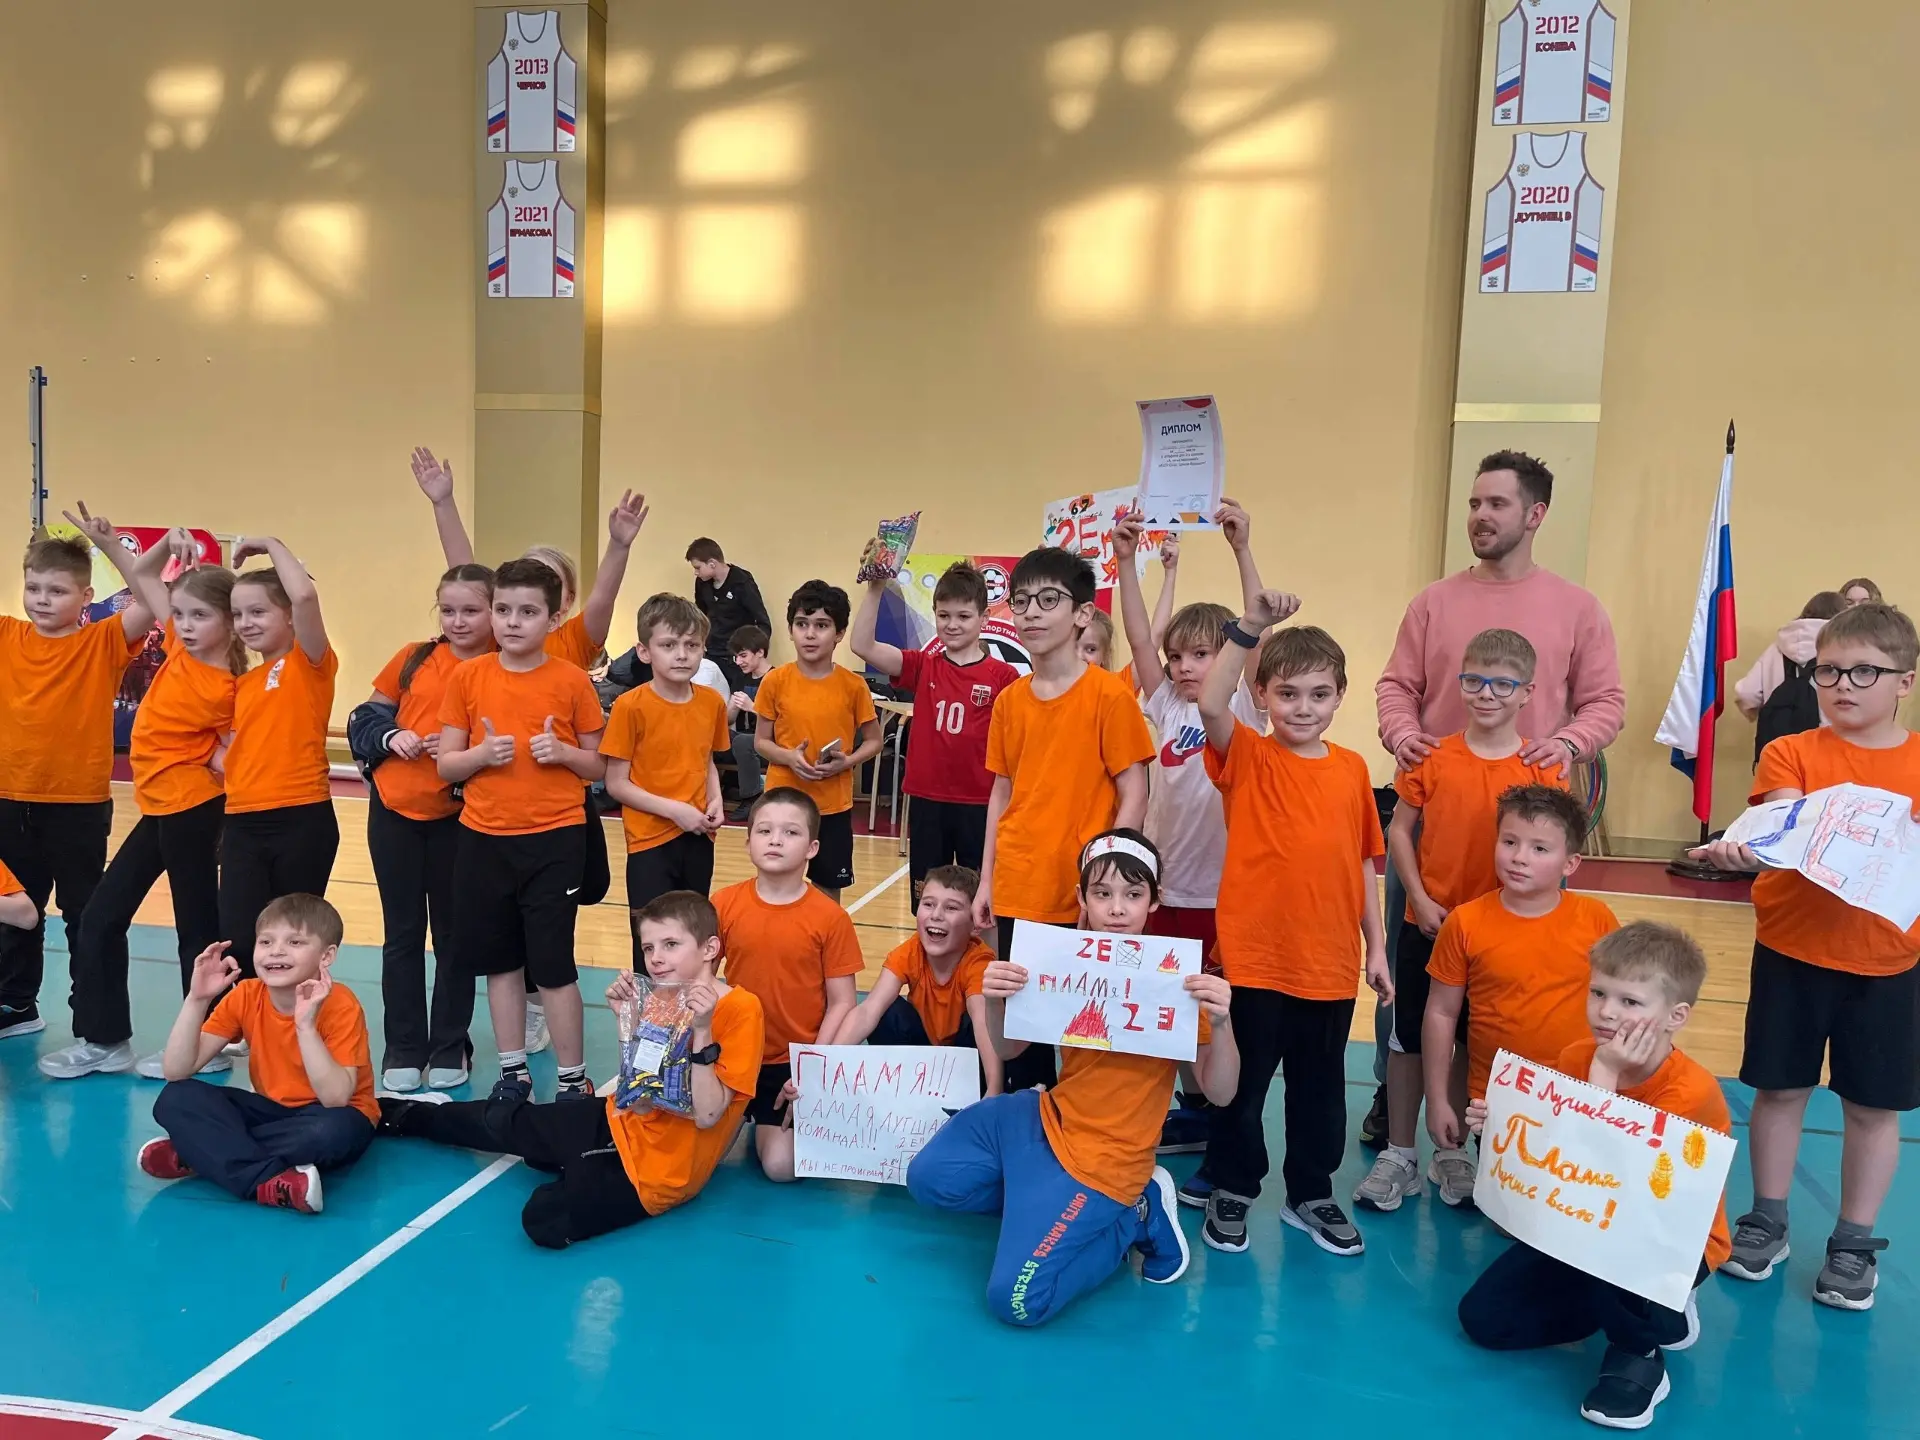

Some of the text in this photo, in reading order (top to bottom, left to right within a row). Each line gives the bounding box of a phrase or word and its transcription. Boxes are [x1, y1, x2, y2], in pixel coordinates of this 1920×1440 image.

[1535, 16, 1580, 34] 2012
[515, 59, 549, 75] 2013
[1520, 186, 1570, 204] 2020
[514, 206, 548, 222] 2021
[1161, 423, 1202, 436] ДИПЛОМ
[935, 700, 965, 735] 10
[797, 1158, 819, 1174] МЫ
[823, 1160, 838, 1172] НЕ
